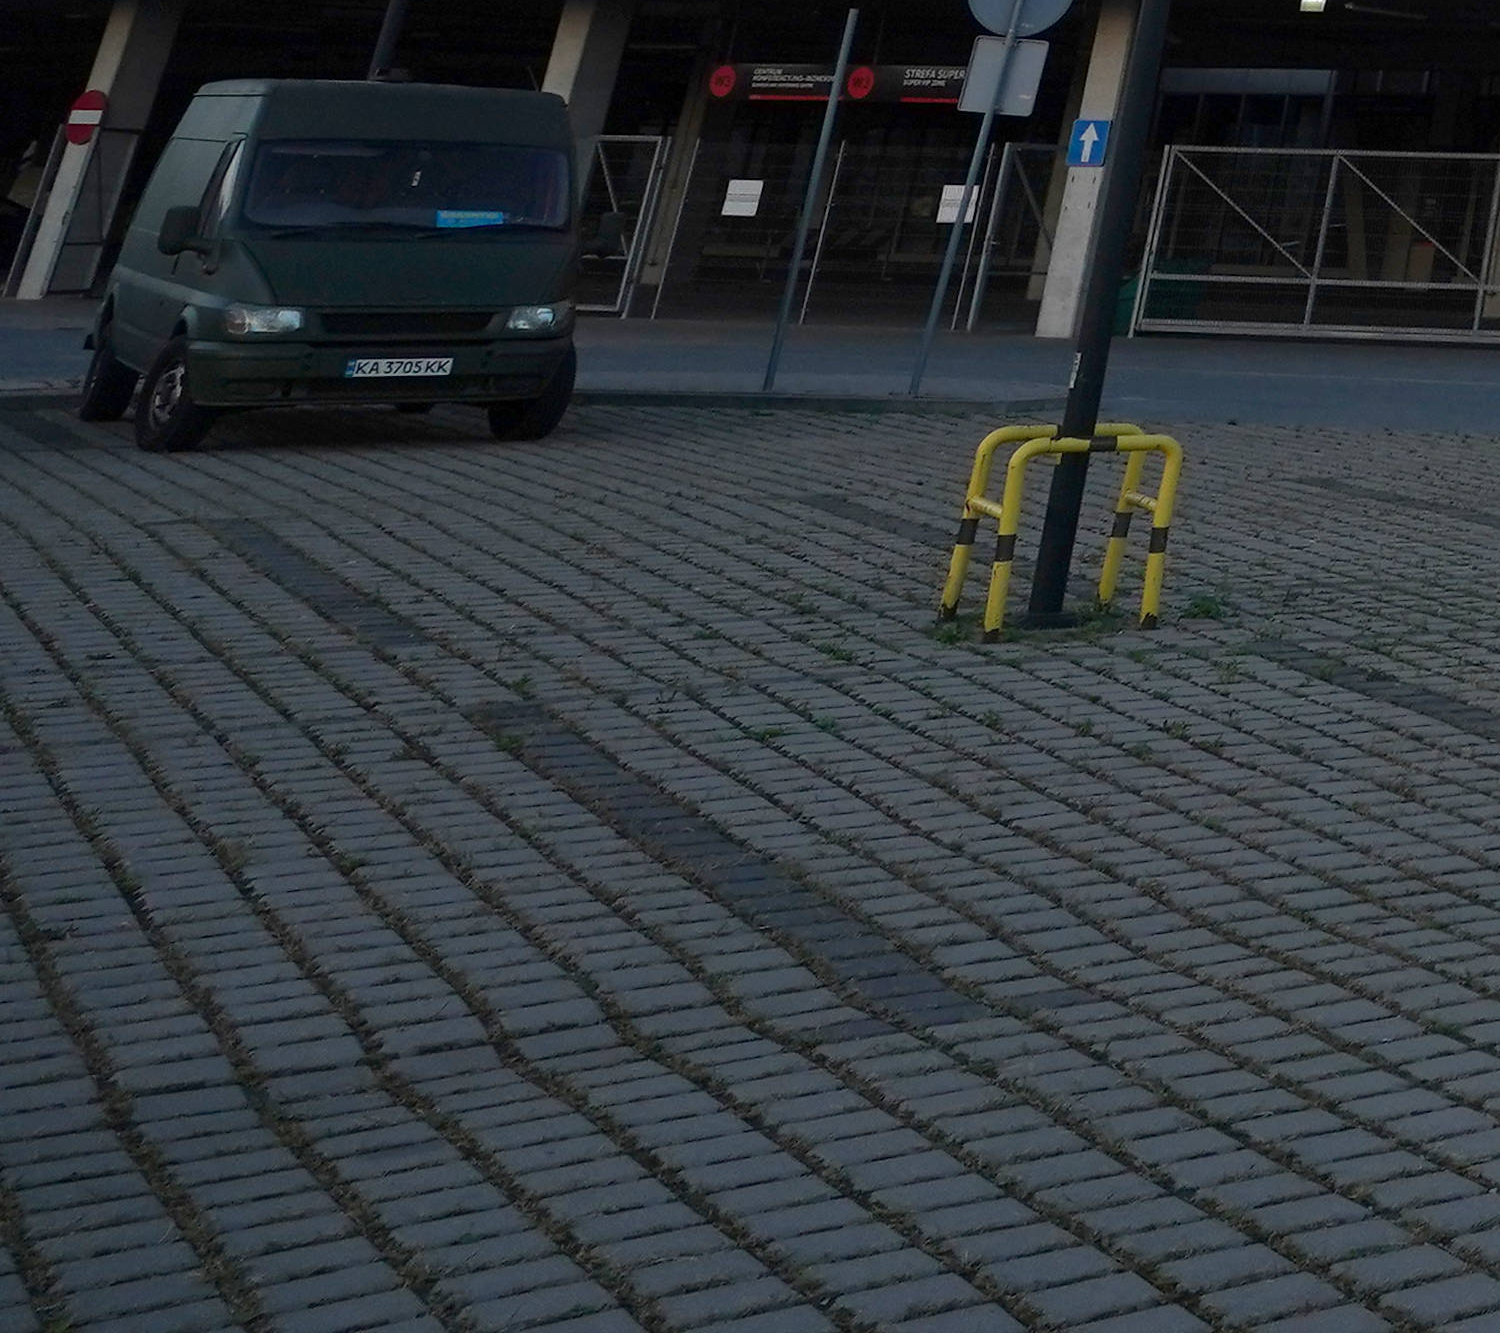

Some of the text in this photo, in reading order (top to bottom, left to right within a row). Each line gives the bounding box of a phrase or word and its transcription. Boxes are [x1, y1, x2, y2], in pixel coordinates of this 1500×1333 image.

[356, 359, 450, 374] KA 3705 KK
